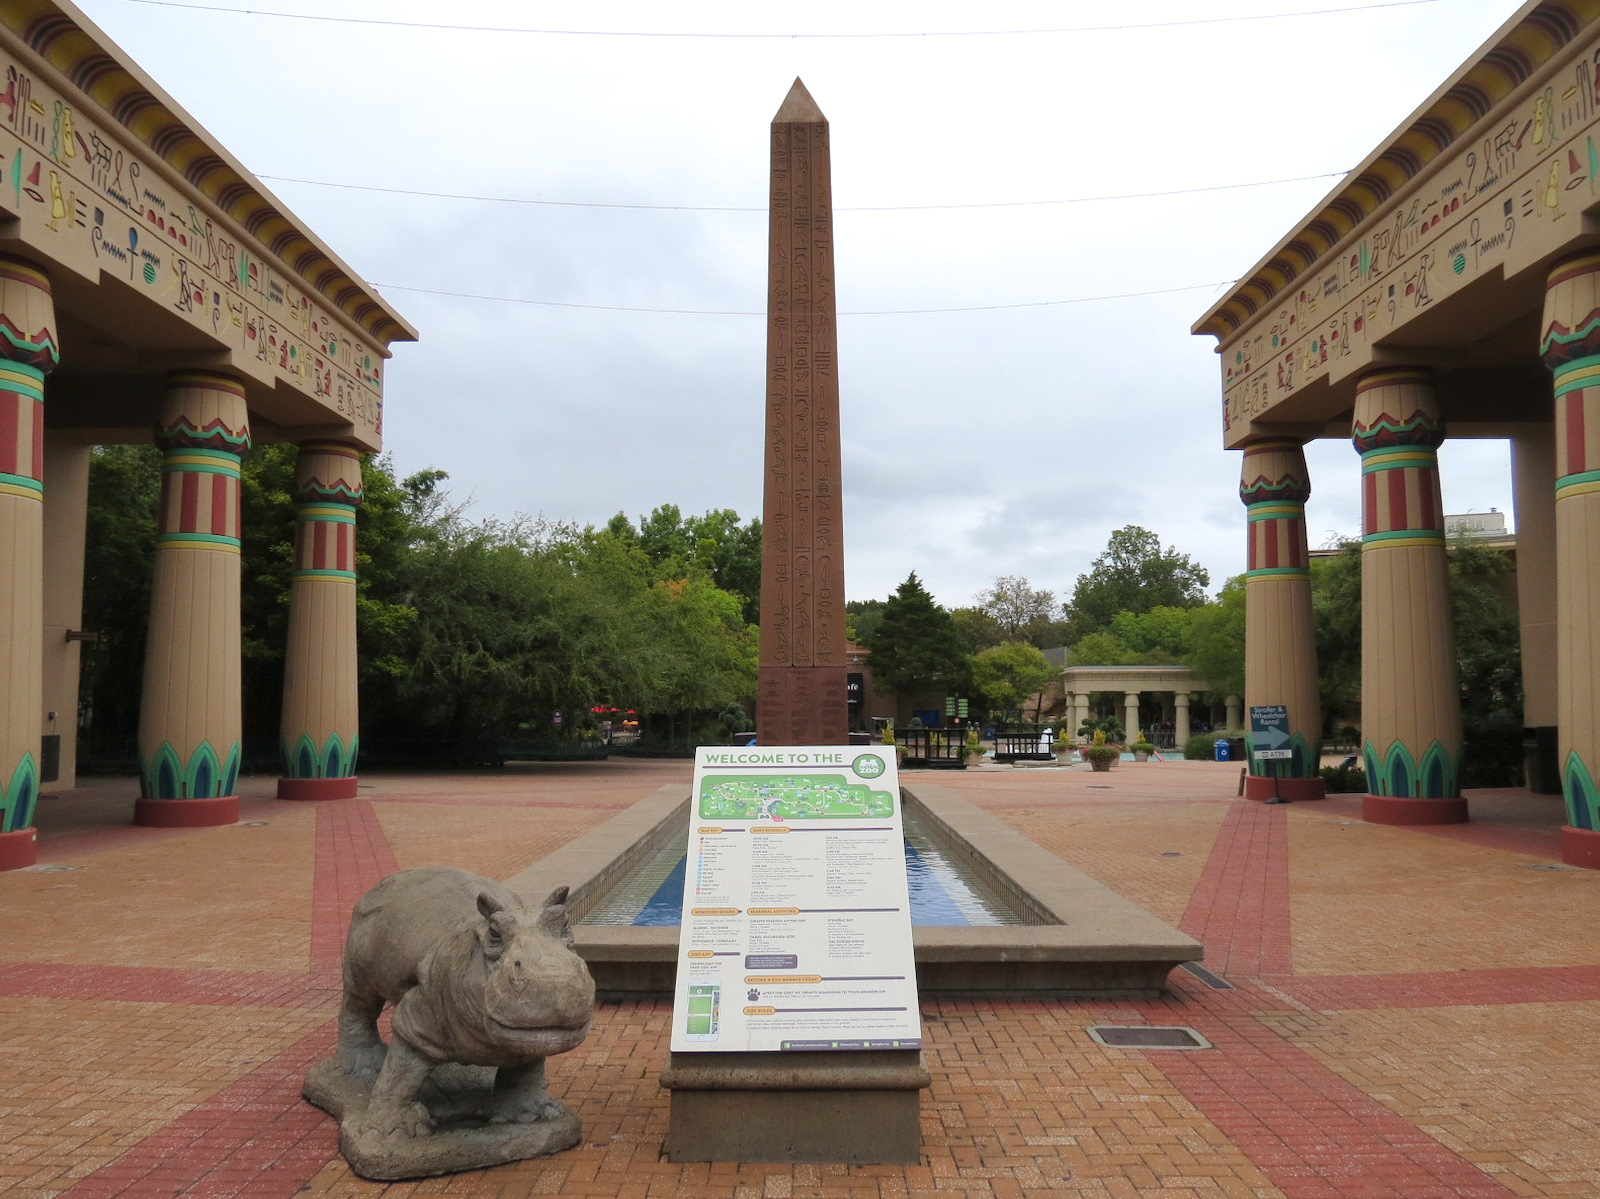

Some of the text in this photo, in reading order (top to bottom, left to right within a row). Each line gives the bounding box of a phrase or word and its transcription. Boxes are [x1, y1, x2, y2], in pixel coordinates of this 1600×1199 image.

[706, 753, 843, 764] WELCOME TO THE
